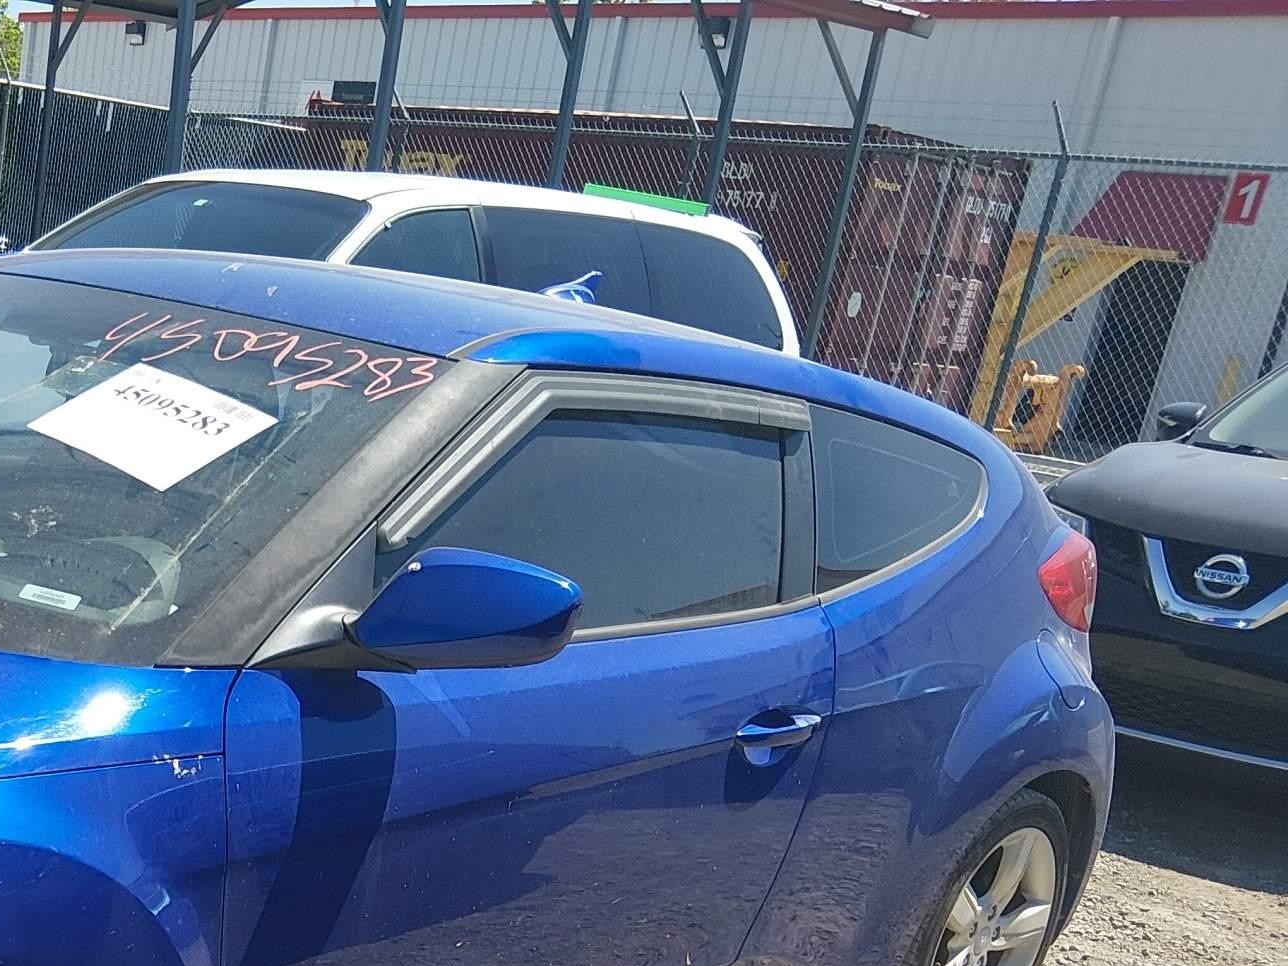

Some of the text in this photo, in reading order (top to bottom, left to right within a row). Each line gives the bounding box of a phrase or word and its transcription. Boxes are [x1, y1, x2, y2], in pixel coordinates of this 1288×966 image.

[1238, 179, 1261, 219] 1
[113, 385, 231, 436] 45095283
[1196, 569, 1242, 584] NISSAN
